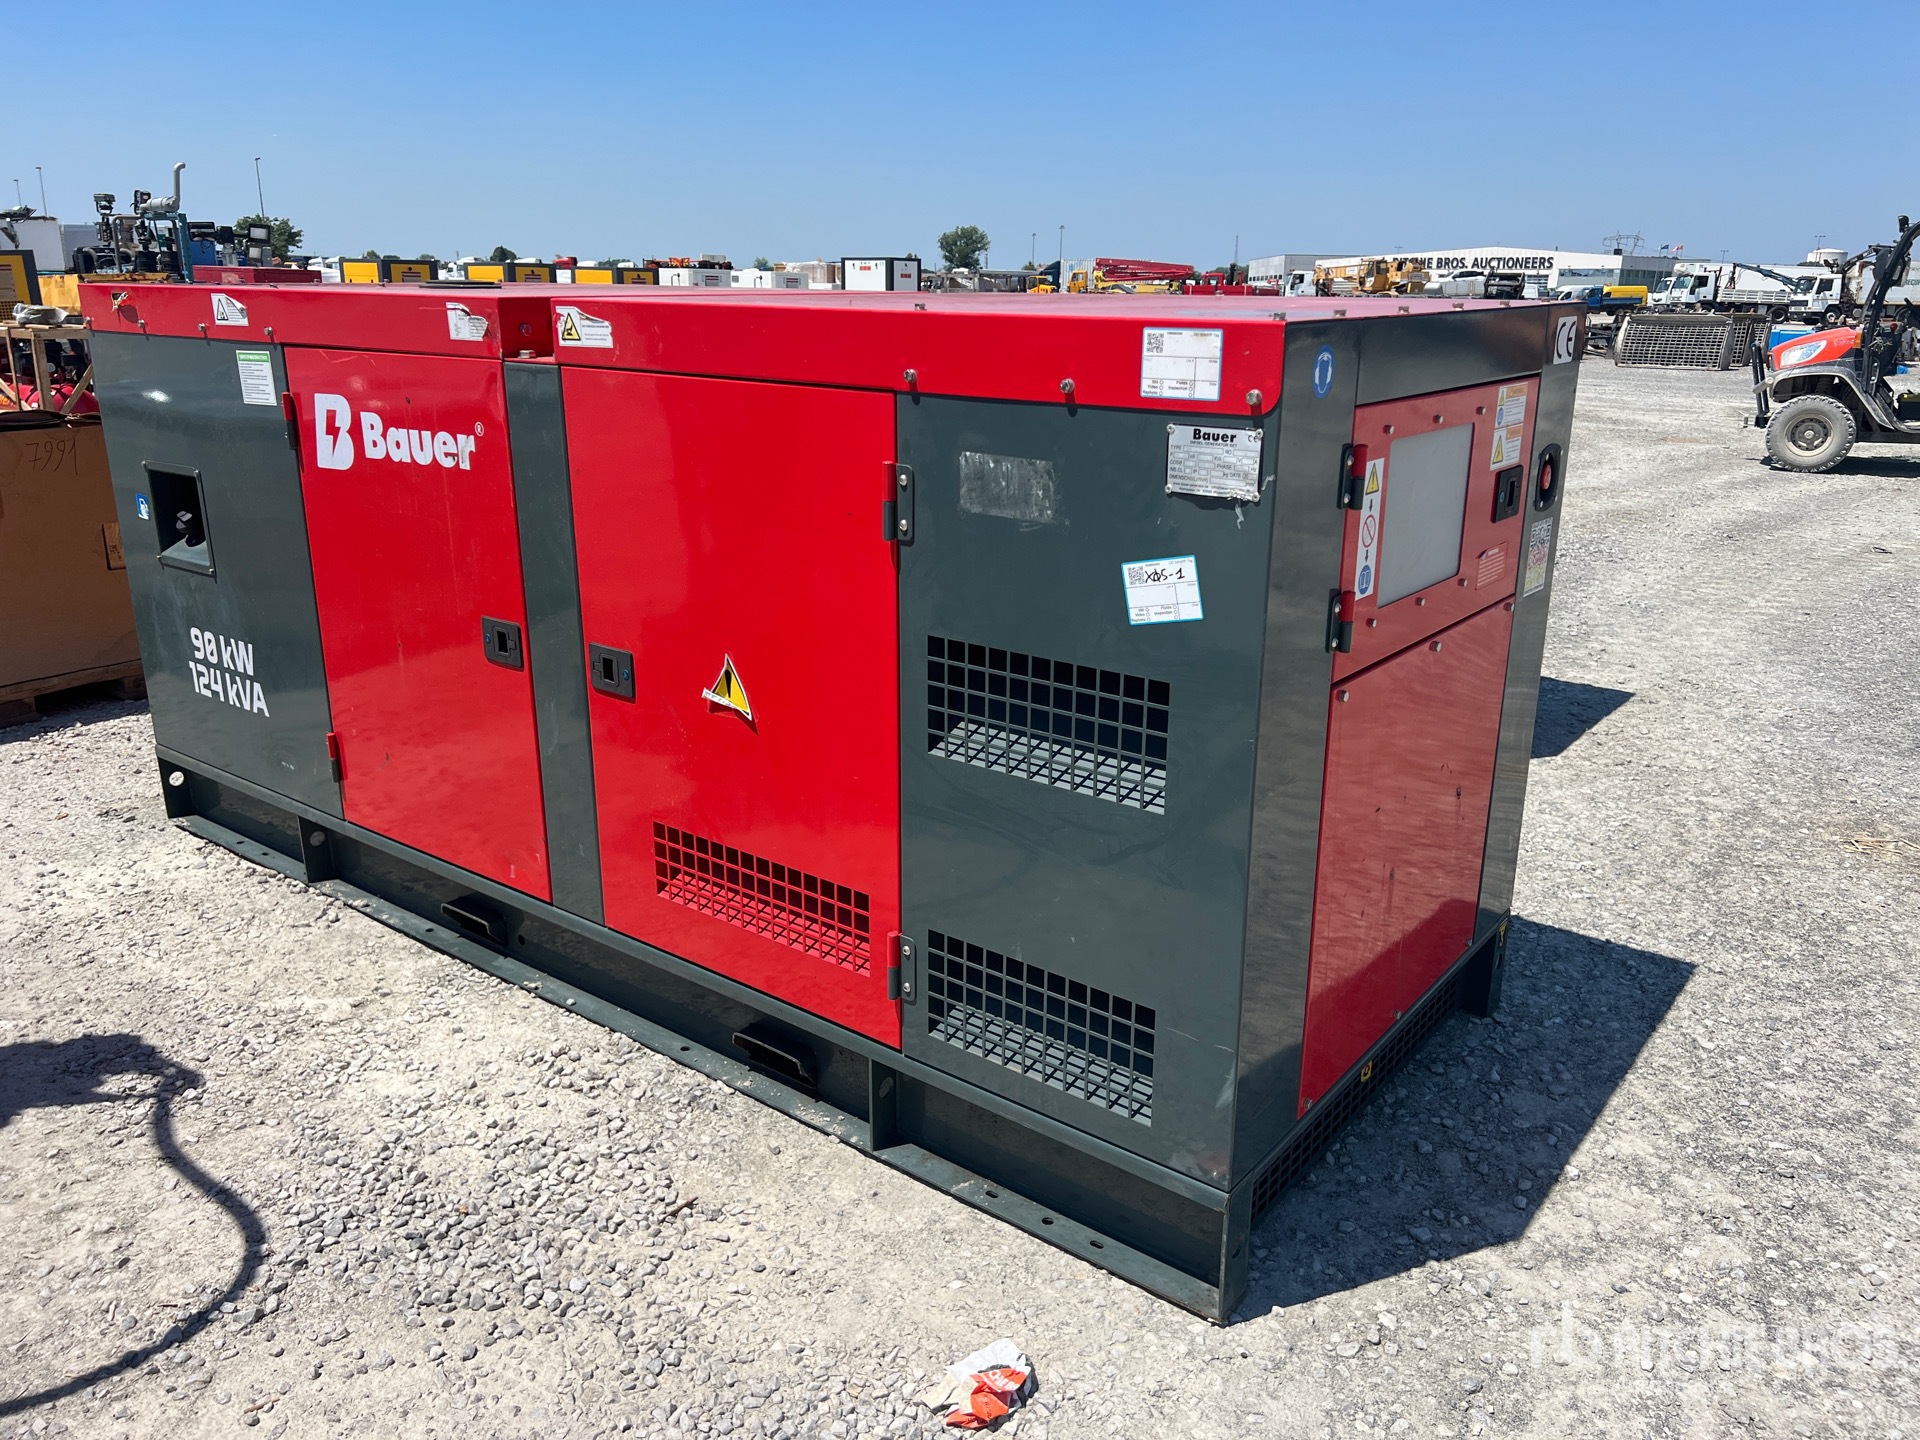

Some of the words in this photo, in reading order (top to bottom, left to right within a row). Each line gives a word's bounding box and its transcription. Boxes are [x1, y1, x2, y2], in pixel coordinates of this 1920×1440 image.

[1436, 257, 1468, 269] BROS.
[1471, 257, 1554, 269] AUCTIONEERS
[1556, 321, 1576, 359] CE
[1193, 428, 1237, 443] Bauer
[219, 635, 254, 676] kW
[189, 661, 225, 702] 124
[225, 672, 270, 717] kVA
